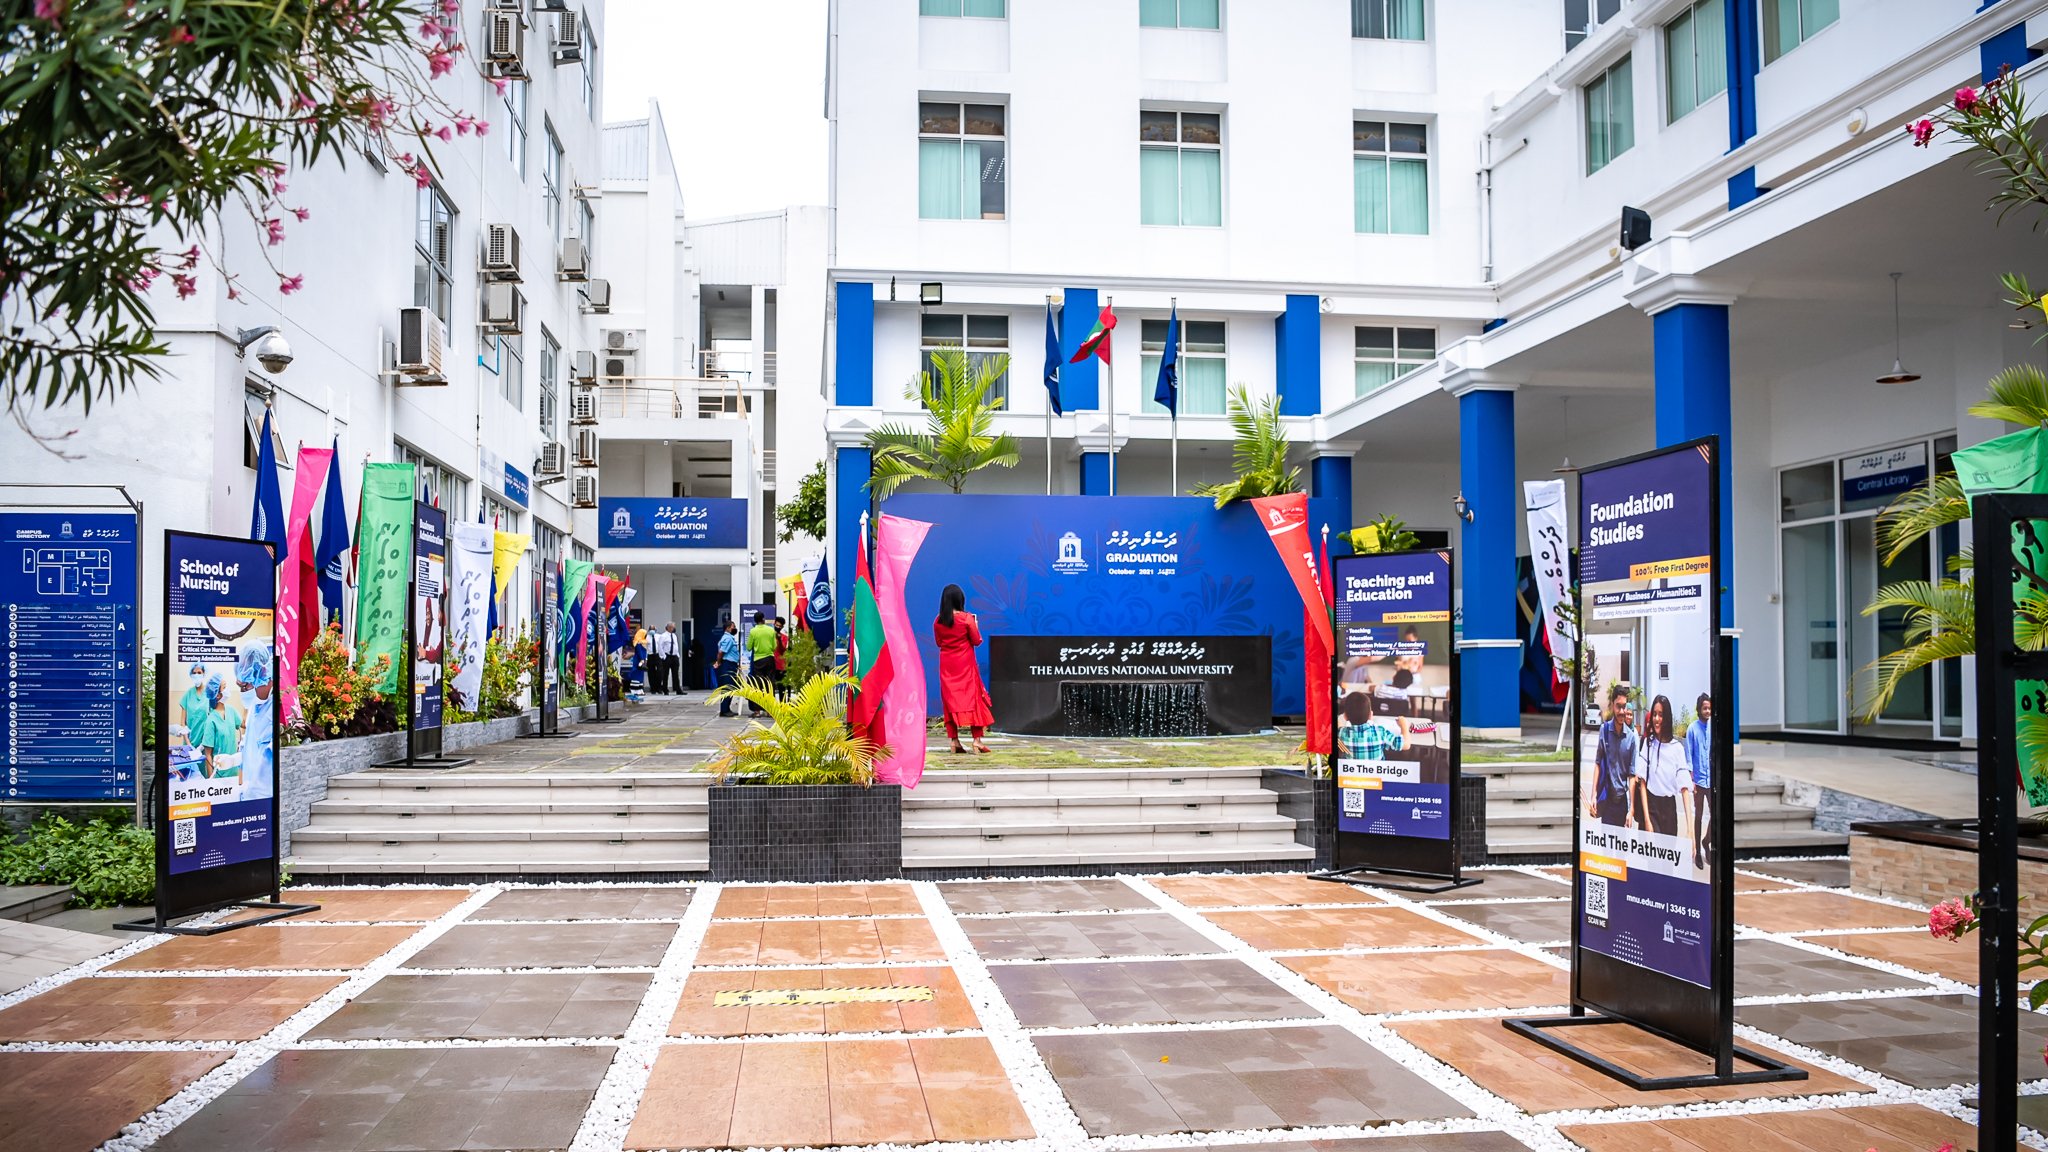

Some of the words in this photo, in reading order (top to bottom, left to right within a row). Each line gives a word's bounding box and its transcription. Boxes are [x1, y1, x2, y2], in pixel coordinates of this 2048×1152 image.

[1858, 479, 1883, 491] Central
[1885, 475, 1909, 486] Library
[1591, 491, 1673, 523] Foundation
[1590, 522, 1643, 547] Studies
[1106, 554, 1177, 563] GRADUATION
[180, 559, 224, 576] School
[226, 563, 240, 576] of
[1636, 566, 1652, 576] 100%
[1654, 565, 1669, 574] Free
[1671, 563, 1684, 572] First
[1686, 561, 1708, 571] Degree
[181, 575, 229, 594] Nursing
[1346, 574, 1405, 589] Teaching
[1408, 572, 1434, 585] and
[1346, 588, 1412, 602] Education
[1625, 590, 1650, 601] Business
[1030, 666, 1052, 675] THE
[1054, 666, 1109, 675] MALDIVES
[1112, 665, 1168, 675] NATIONAL
[1170, 665, 1234, 675] UNIVERSITY
[118, 686, 125, 694] C
[1356, 765, 1374, 774] The
[1376, 766, 1408, 777] Bridge
[174, 790, 186, 800] Be
[188, 788, 205, 799] The
[207, 786, 232, 797] Carer
[212, 818, 242, 827] mnu.edu.mv
[1586, 830, 1606, 847] Find
[1608, 834, 1628, 851] The
[1631, 839, 1681, 866] Pathway
[1627, 894, 1665, 910] mnu.edu.mv
[1670, 904, 1686, 915] 3345
[1688, 908, 1700, 918] 155
[1588, 917, 1599, 925] SCAN
[1599, 920, 1606, 928] ME
